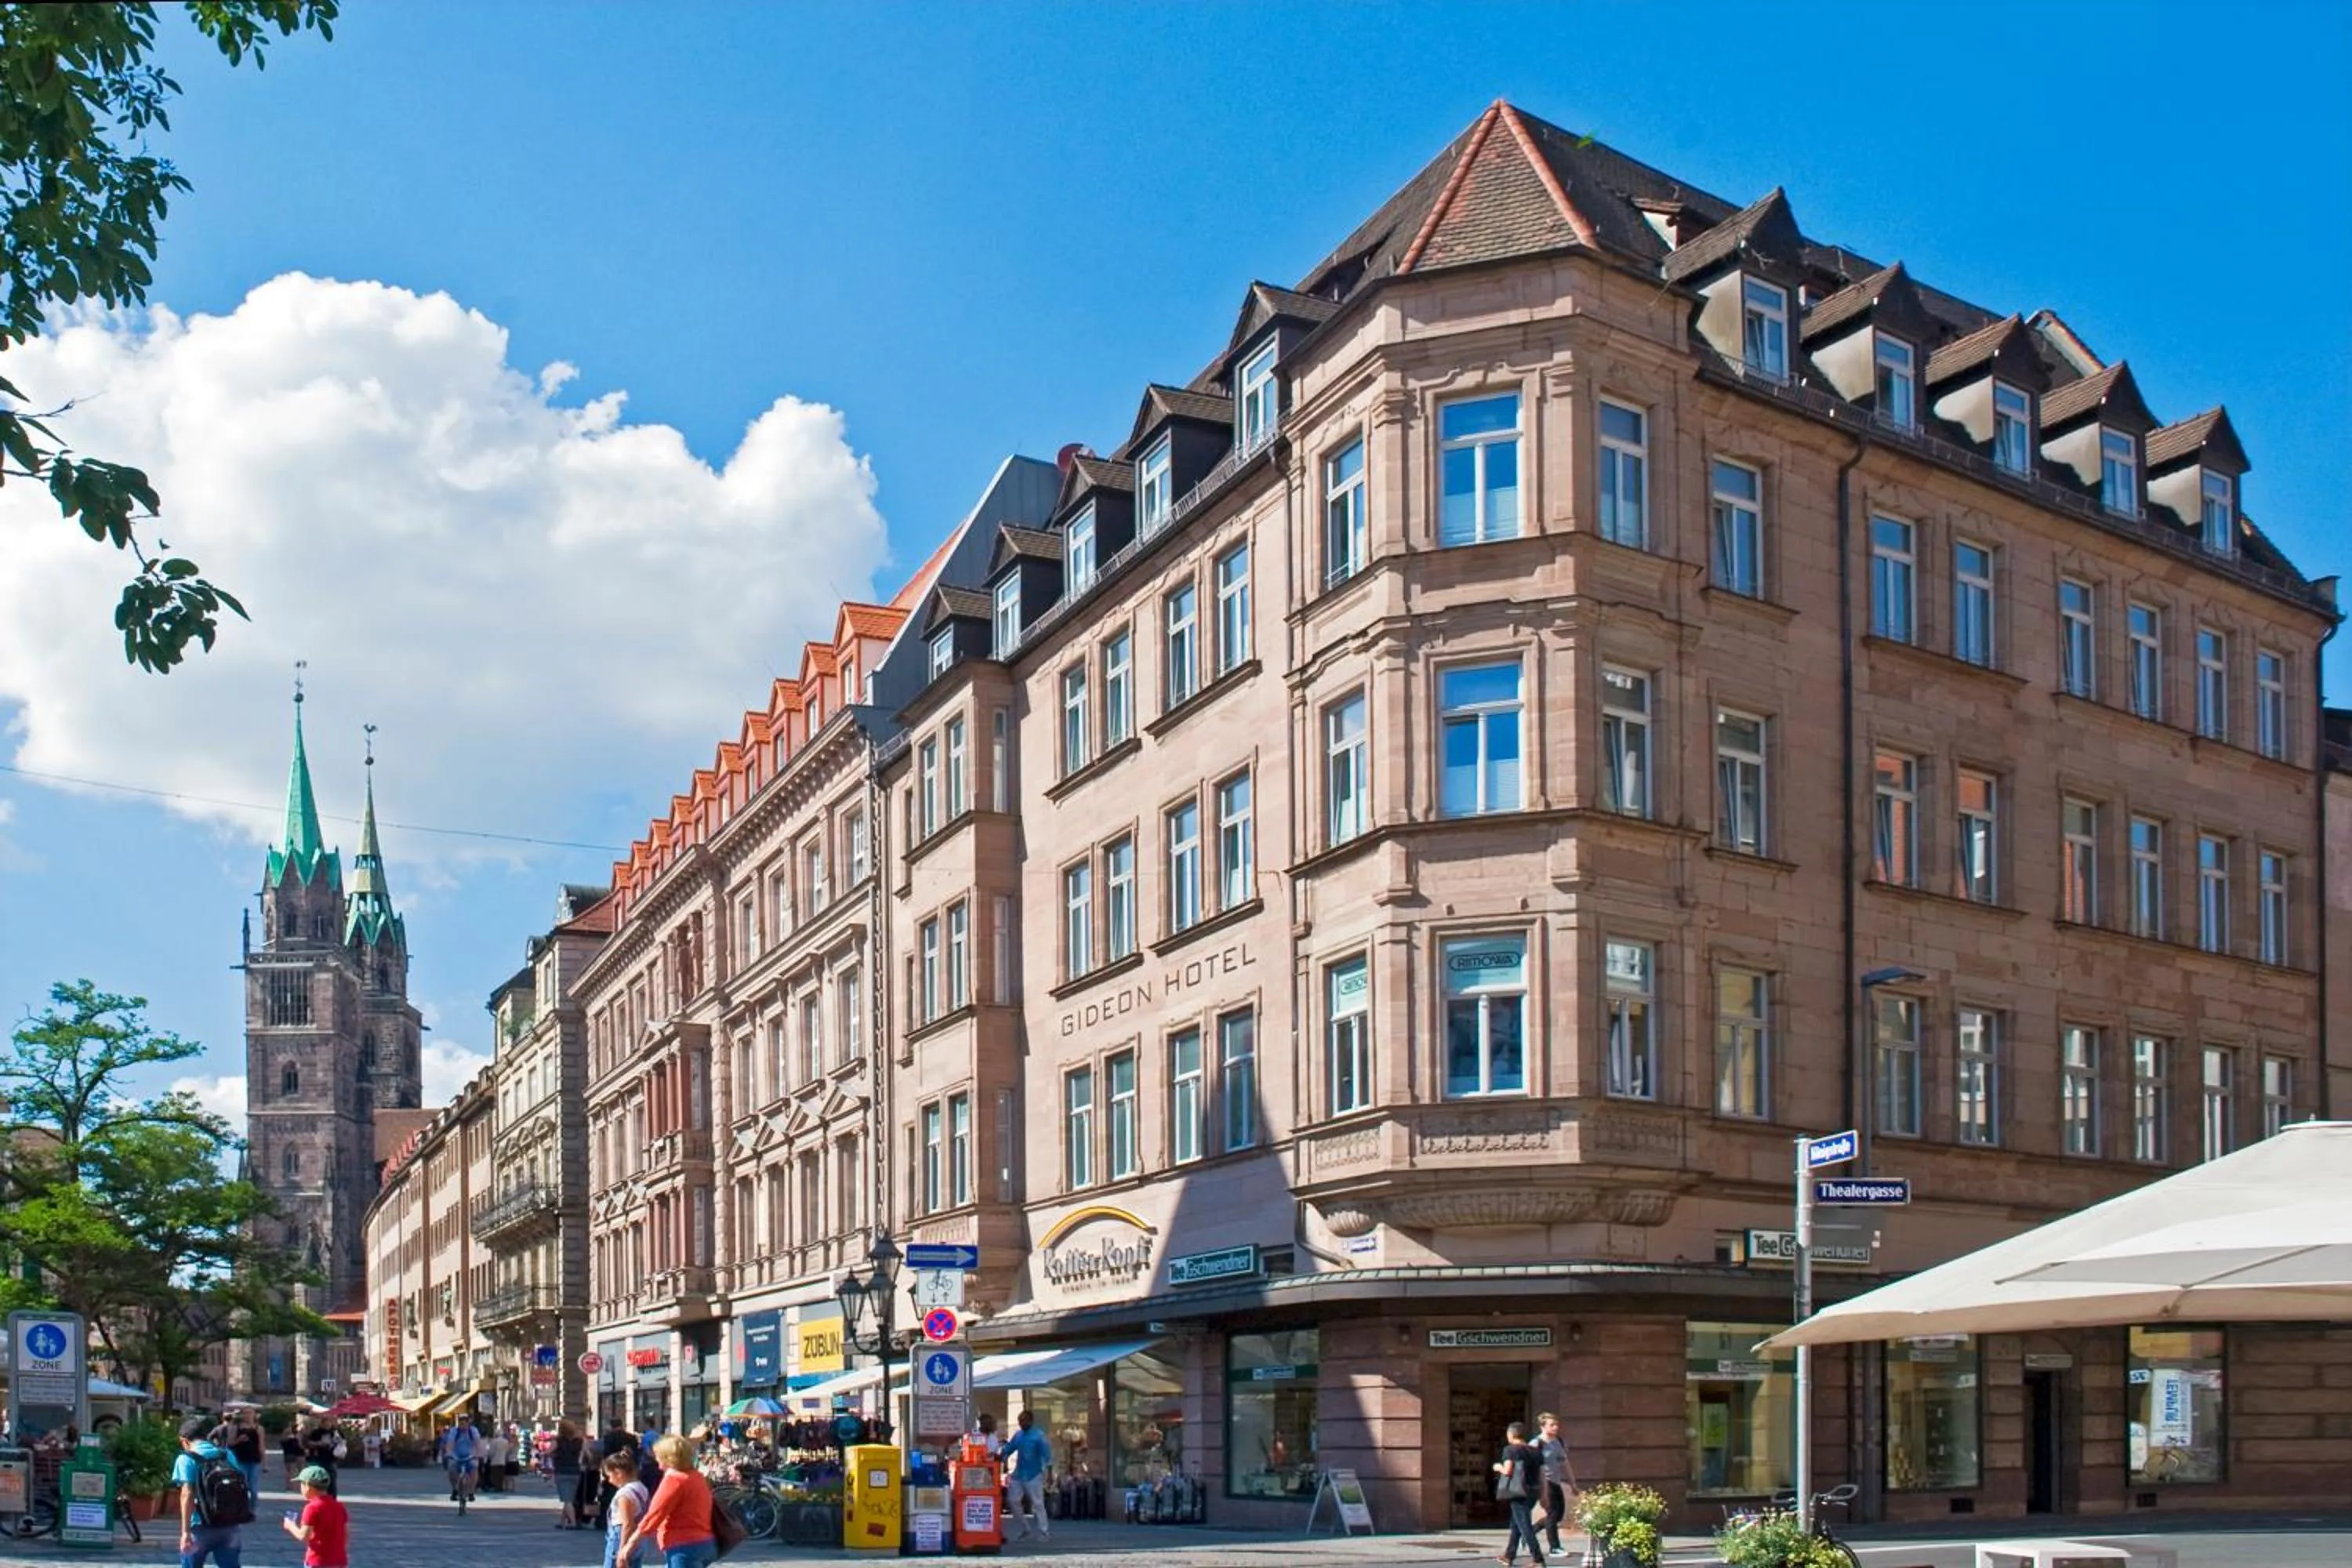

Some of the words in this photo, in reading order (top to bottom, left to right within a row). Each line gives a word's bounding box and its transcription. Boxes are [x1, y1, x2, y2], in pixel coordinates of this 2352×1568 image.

[1457, 953, 1515, 968] RIMOWA
[1061, 982, 1152, 1036] GIDEON
[1165, 943, 1257, 996] HOTEL
[1820, 1183, 1904, 1200] Theatergasse
[1755, 1235, 1777, 1254] Tee
[1171, 1261, 1185, 1281] Tee
[387, 1298, 398, 1375] APOTHEKE
[1434, 1333, 1454, 1345] Tee
[1457, 1331, 1546, 1344] Gschwendner
[31, 1360, 61, 1370] ZONE
[929, 1385, 954, 1395] ZONE
